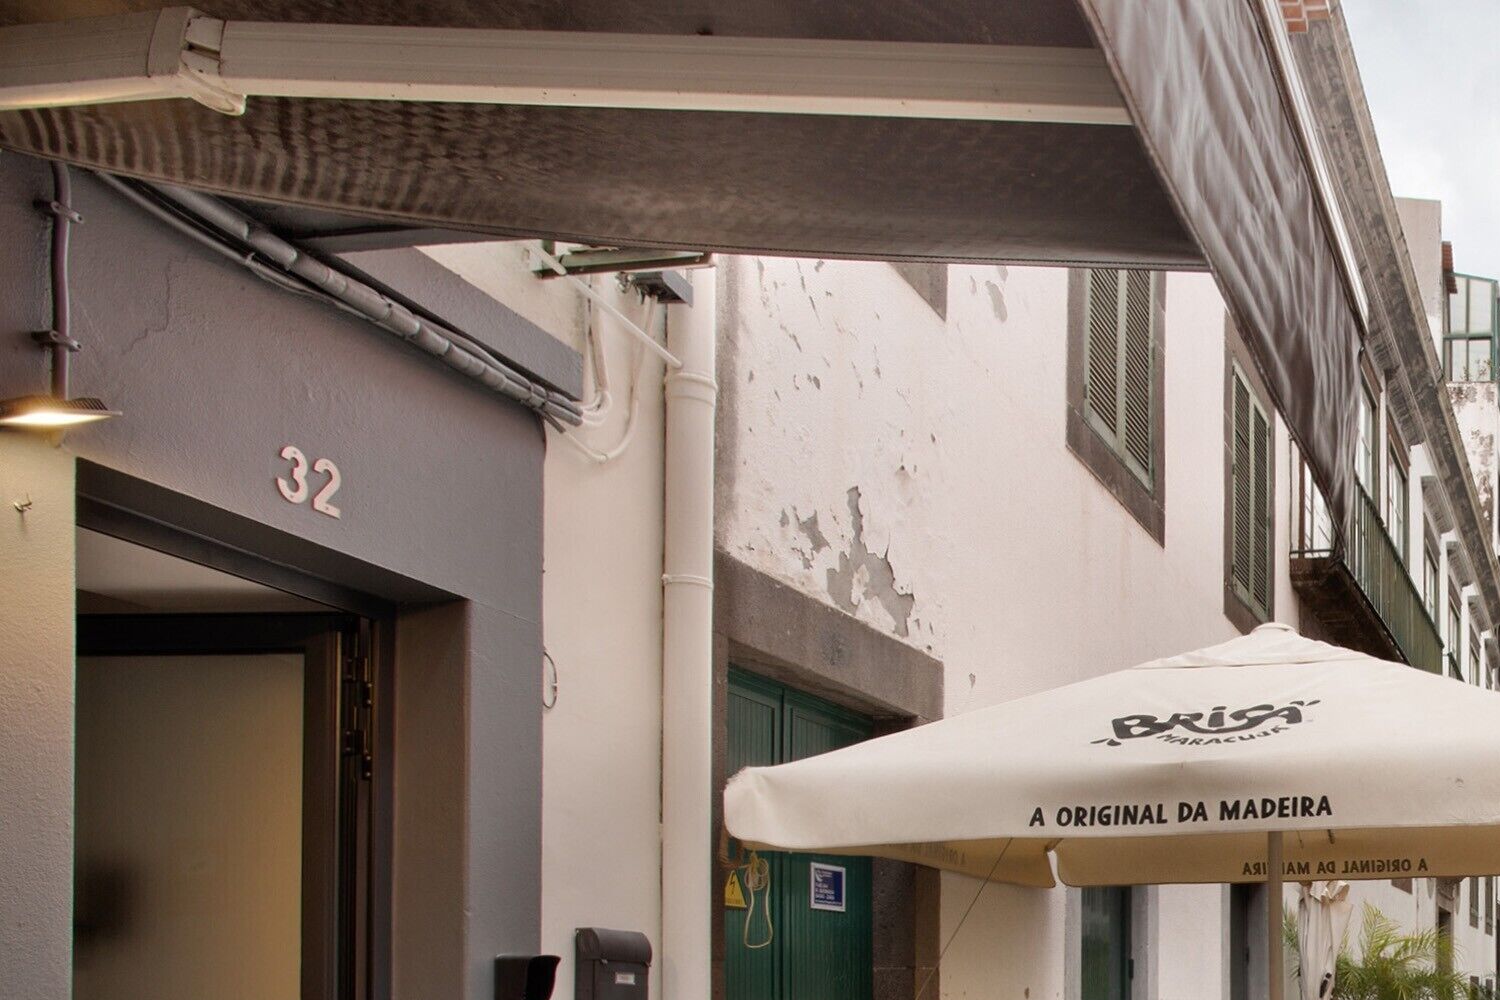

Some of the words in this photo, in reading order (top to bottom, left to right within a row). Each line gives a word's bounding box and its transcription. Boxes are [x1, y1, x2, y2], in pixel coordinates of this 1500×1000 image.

[276, 445, 342, 520] 32
[1029, 807, 1045, 827] A
[1056, 803, 1168, 827] ORIGINAL
[1178, 802, 1209, 823] DA
[1219, 796, 1333, 821] MADEIRA
